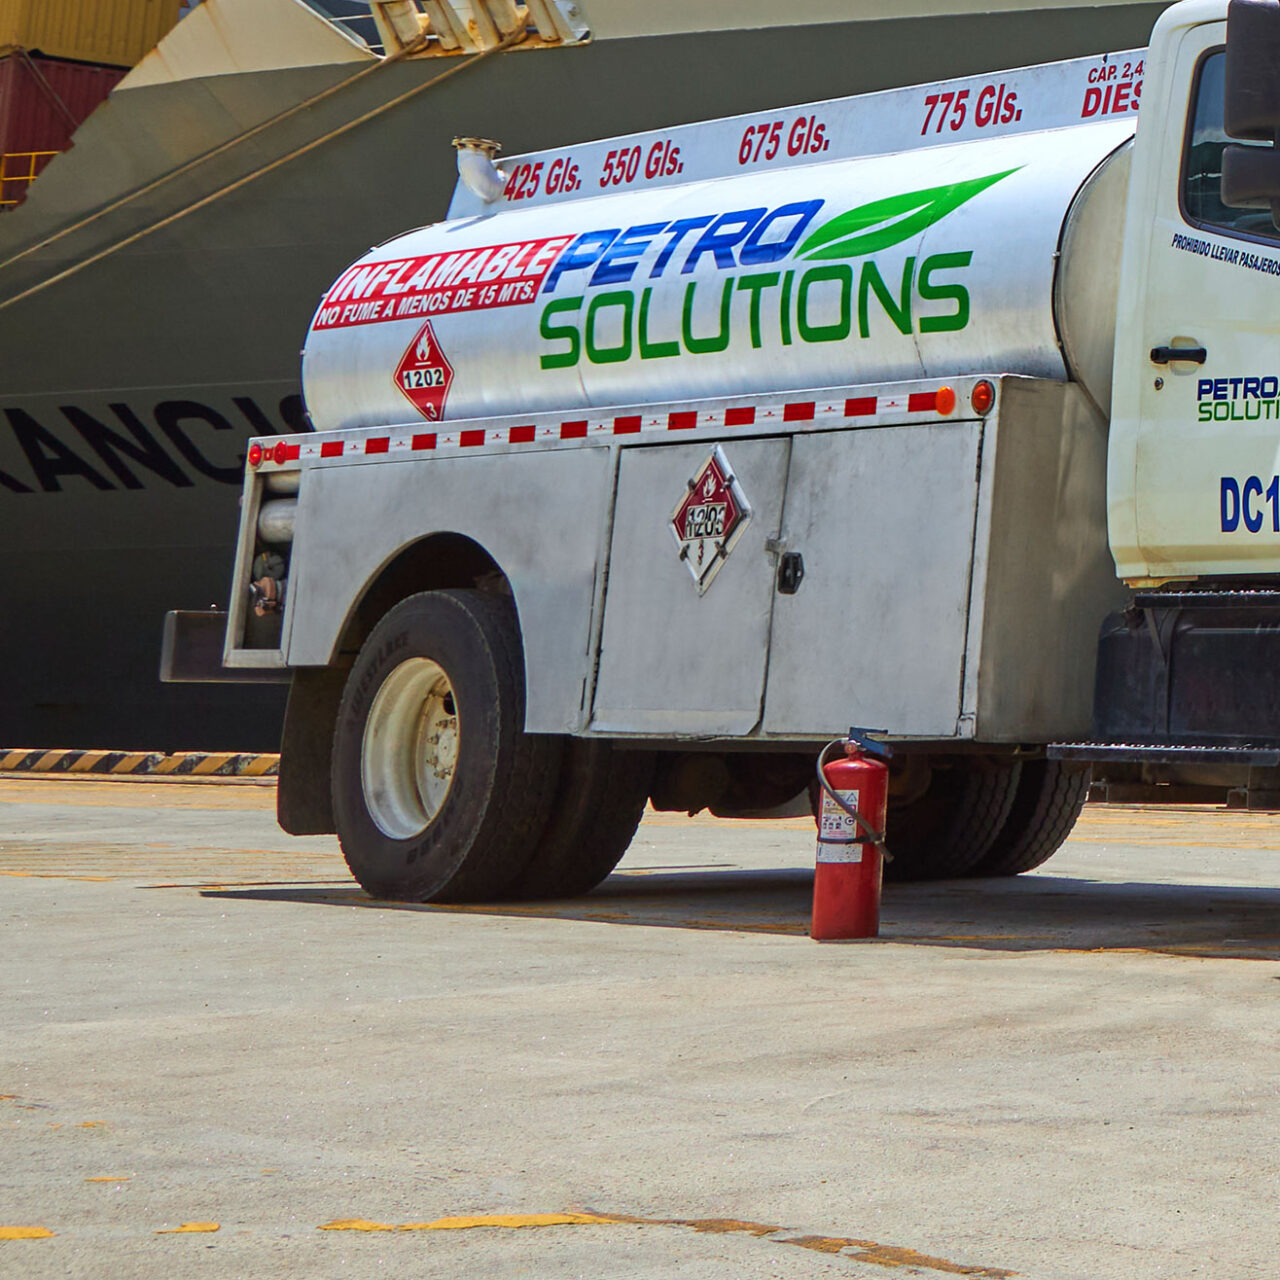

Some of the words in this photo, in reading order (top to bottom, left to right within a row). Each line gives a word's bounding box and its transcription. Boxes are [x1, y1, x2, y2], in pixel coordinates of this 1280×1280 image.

[1088, 64, 1118, 84] CAP.
[1121, 60, 1144, 81] 2,4
[503, 161, 545, 202] 425
[545, 157, 582, 195] Gls.
[600, 145, 642, 188] 550
[645, 139, 684, 180] Gls.
[738, 120, 785, 165] 675
[787, 113, 830, 157] Gls.
[921, 88, 970, 136] 775
[974, 83, 1023, 128] Gls.
[542, 198, 826, 294] PETRO
[1171, 232, 1212, 258] PROHIBIDO
[1210, 243, 1240, 265] LLEVAR
[328, 238, 569, 303] INFLAMABLE
[317, 307, 338, 327] NO
[340, 299, 382, 323] FUME
[381, 298, 395, 318] A
[394, 291, 452, 316] MENOS
[451, 288, 473, 308] DE
[478, 285, 496, 305] 15
[497, 280, 535, 304] MTS.
[539, 250, 974, 370] SOLUTIONS
[404, 368, 444, 388] 1202
[1197, 376, 1279, 401] PETRO
[426, 402, 438, 418] 3
